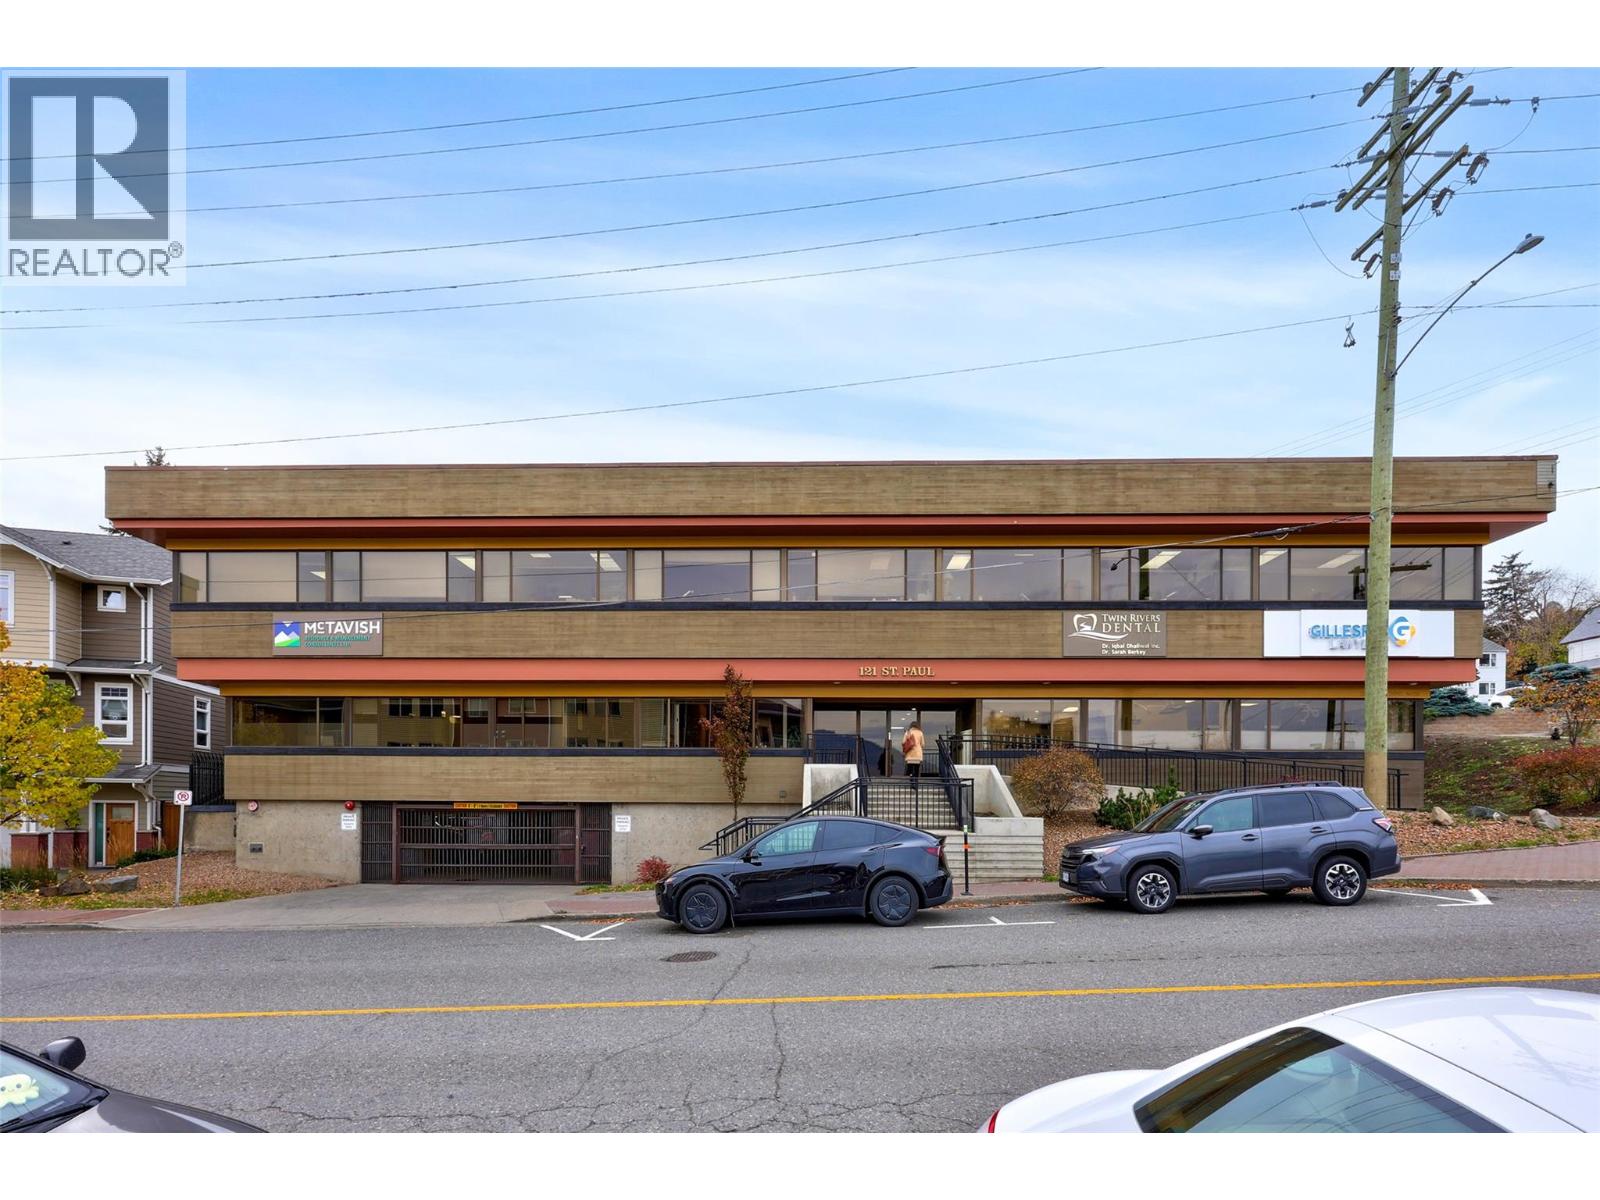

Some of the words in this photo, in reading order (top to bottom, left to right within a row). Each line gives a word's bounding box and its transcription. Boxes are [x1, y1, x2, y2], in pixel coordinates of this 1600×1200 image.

[1101, 613, 1127, 623] TWIN
[1130, 613, 1161, 623] RIVERS
[1102, 622, 1161, 633] DENTAL
[1310, 624, 1369, 638] GILLESP
[859, 666, 877, 676] 121
[881, 666, 900, 676] ST.
[903, 666, 935, 676] PAUL
